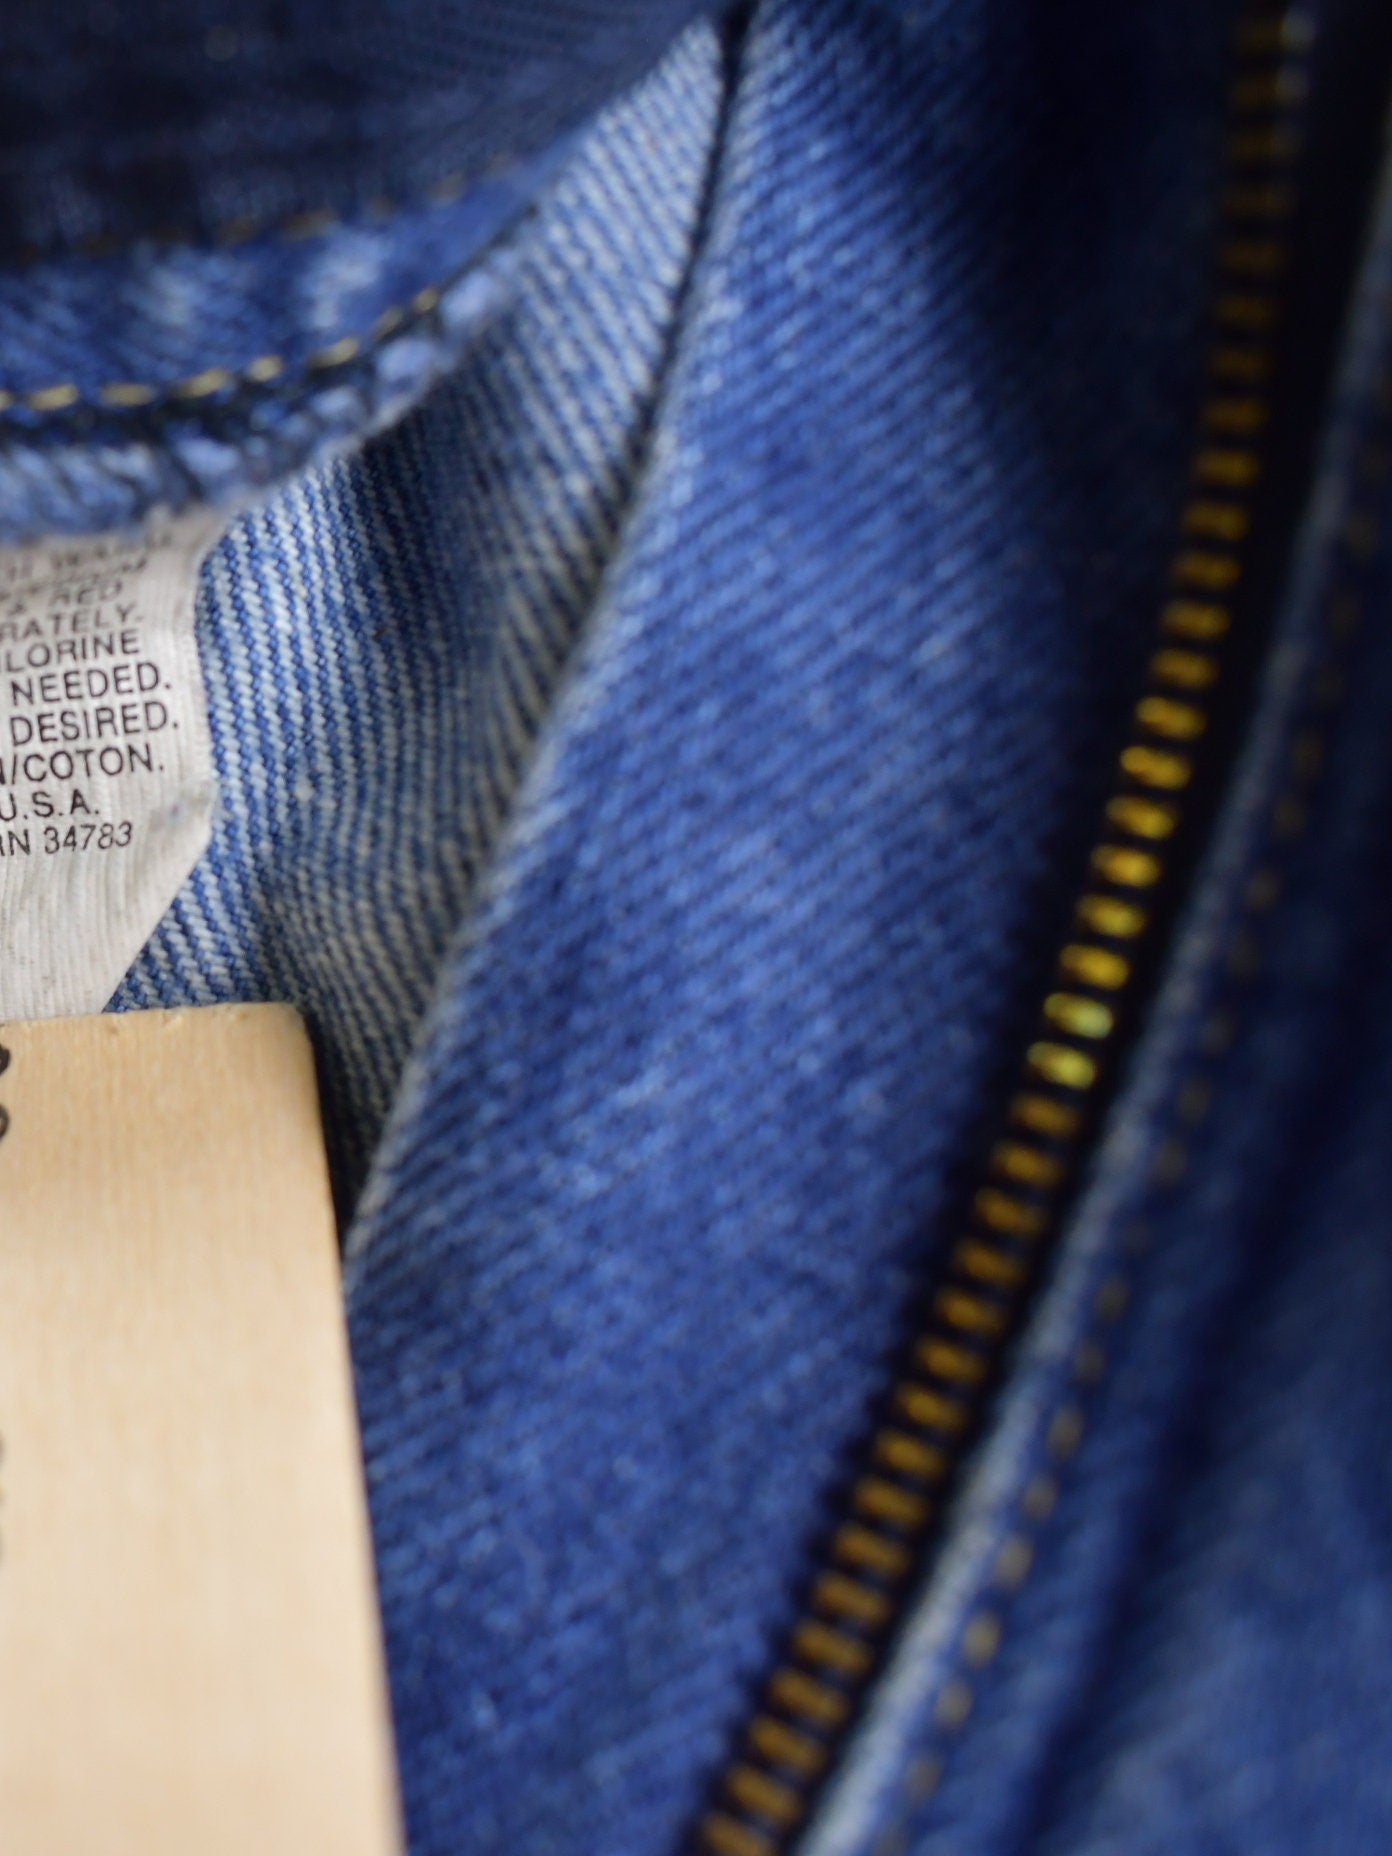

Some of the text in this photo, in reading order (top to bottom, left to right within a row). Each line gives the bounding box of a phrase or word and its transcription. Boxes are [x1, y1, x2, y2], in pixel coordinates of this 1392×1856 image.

[10, 661, 173, 707] NEEDED.
[9, 700, 180, 747] DESIRED.
[42, 820, 134, 855] 34783
